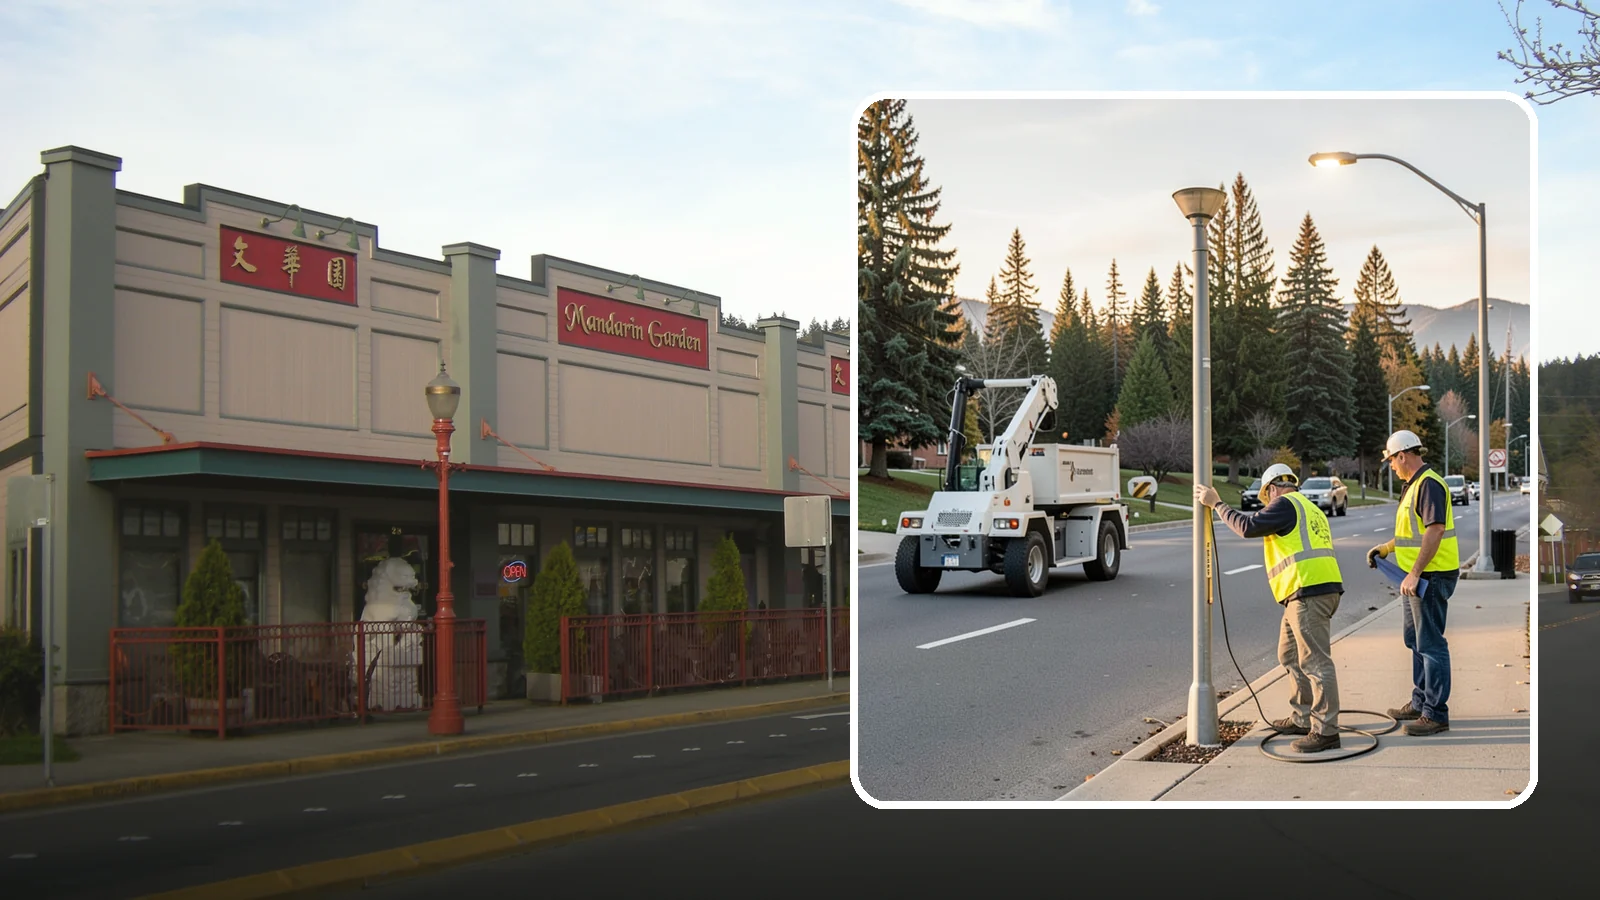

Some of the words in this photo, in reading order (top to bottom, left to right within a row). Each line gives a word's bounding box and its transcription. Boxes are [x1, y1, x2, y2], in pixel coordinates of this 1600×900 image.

[564, 302, 644, 341] Mandarin
[648, 320, 701, 352] Garden
[503, 565, 527, 578] OPEN
